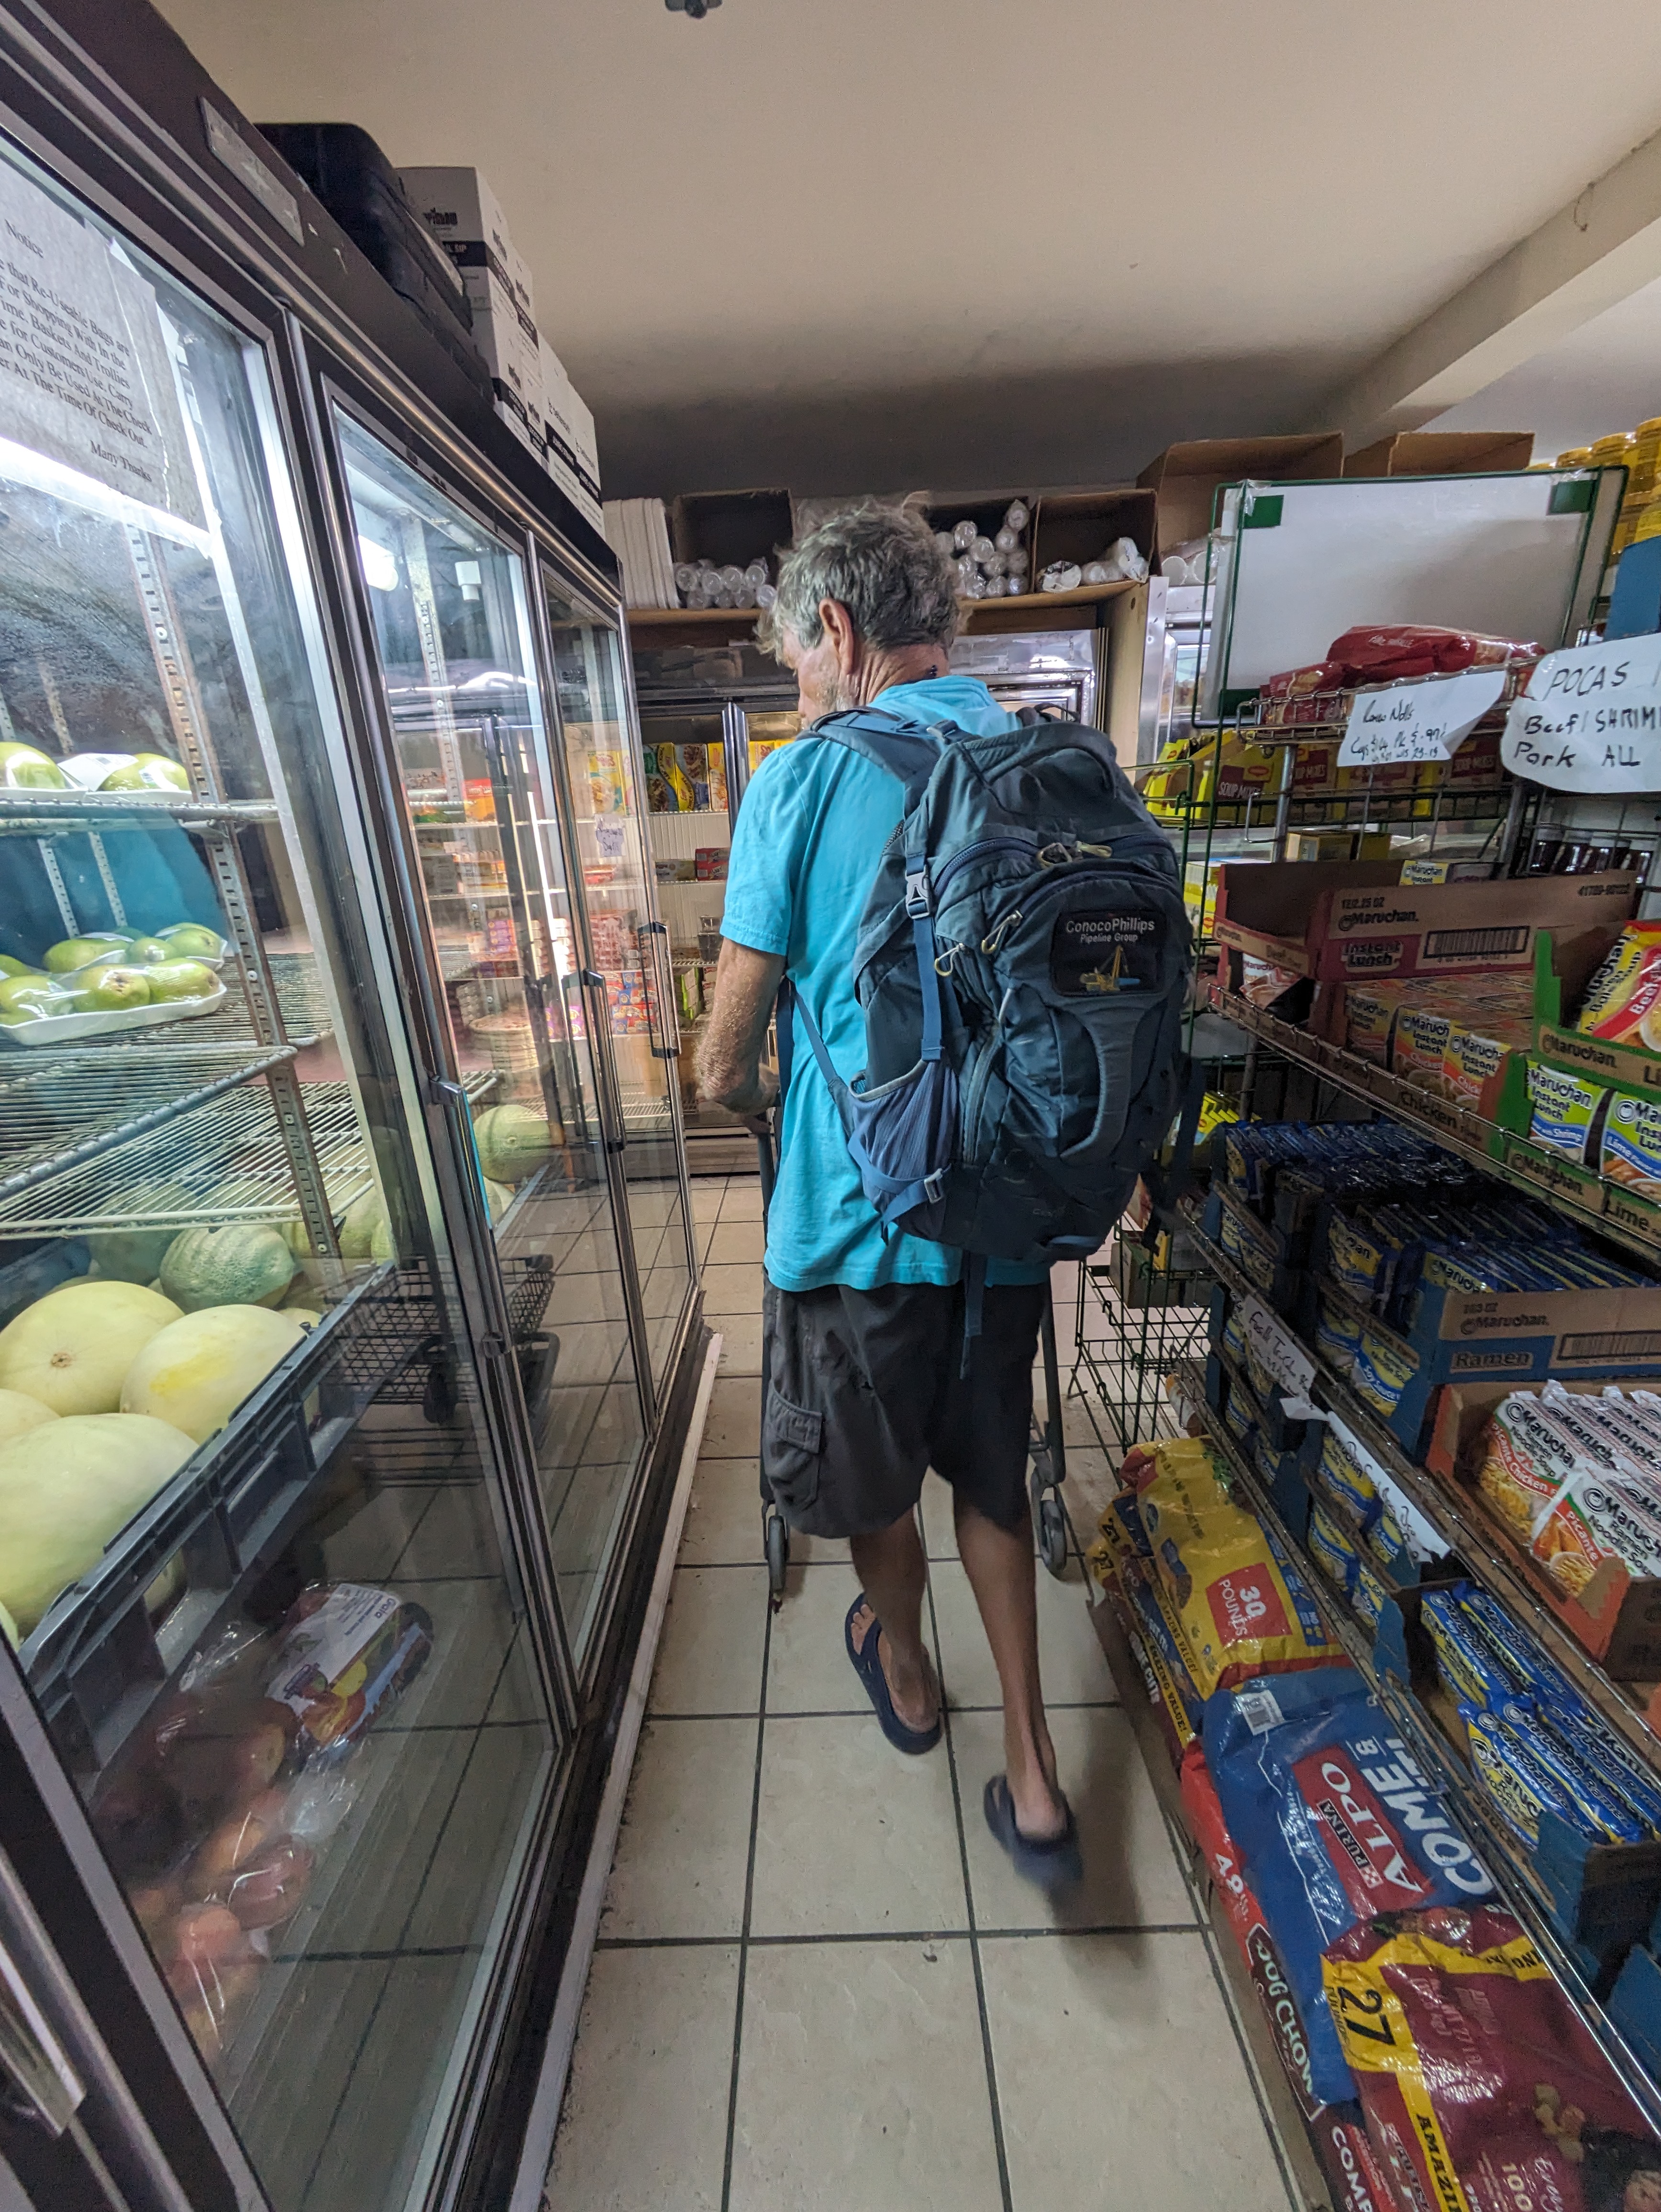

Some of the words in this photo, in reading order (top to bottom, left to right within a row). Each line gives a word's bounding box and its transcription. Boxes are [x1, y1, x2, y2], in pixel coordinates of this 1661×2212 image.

[4, 219, 44, 258] Notice
[7, 262, 29, 287] that
[30, 274, 88, 329] Re-Useable
[89, 319, 114, 346] Bags
[116, 341, 130, 357] are
[22, 289, 74, 338] Shopping
[74, 325, 97, 353] With
[98, 342, 110, 361] In
[111, 352, 126, 371] the
[10, 320, 28, 343] for
[108, 384, 133, 411] Carry
[30, 312, 72, 351] Baskets
[74, 344, 93, 366] And
[92, 355, 131, 389] Trollies
[14, 362, 30, 381] At
[30, 366, 54, 395] The
[55, 379, 83, 411] Time
[83, 402, 97, 419] Of
[98, 409, 127, 438] Check
[128, 427, 148, 449] Out.
[16, 343, 44, 374] Only
[46, 360, 64, 382] Be
[63, 371, 90, 398] Used
[103, 397, 123, 418] The
[123, 410, 153, 435] Check
[89, 440, 119, 468] Many
[120, 455, 153, 483] Thanks
[1542, 661, 1630, 702] POCAS
[1514, 741, 1576, 768] Pork
[1602, 744, 1641, 768] ALL
[1066, 917, 1155, 934] ConocoPhillips
[1080, 933, 1112, 945] Pipeline
[1114, 933, 1139, 944] Group
[1344, 942, 1401, 955] Instant
[1348, 952, 1393, 967] Lunch
[1413, 1029, 1448, 1048] Instant
[1416, 1040, 1443, 1055] Lunch
[1401, 1091, 1457, 1130] Chicken
[1606, 1135, 1632, 1158] Lime
[1602, 1185, 1650, 1231] Lime
[1455, 1351, 1530, 1369] Ramen
[1491, 1422, 1512, 1467] Picante
[1509, 1463, 1548, 1491] Chicken
[1536, 1454, 1556, 1478] Soup
[1567, 1510, 1600, 1561] Picante
[1588, 1515, 1630, 1554] Noodle
[1610, 1522, 1649, 1561] Ramen
[1093, 1550, 1114, 1572] 27
[1218, 1579, 1250, 1638] POUNDS
[1238, 1587, 1267, 1621] 30
[1164, 1692, 1189, 1732] VALUE!
[1354, 1736, 1379, 1760] &
[1500, 1723, 1554, 1793] Maruchan
[1530, 1721, 1585, 1777] Maruchan
[1317, 1797, 1372, 1868] PURINA
[1320, 1759, 1425, 1894] ALPO
[1367, 1754, 1491, 1896] COME
[1336, 1986, 1396, 2048] 27
[1275, 2000, 1313, 2094] CHOW
